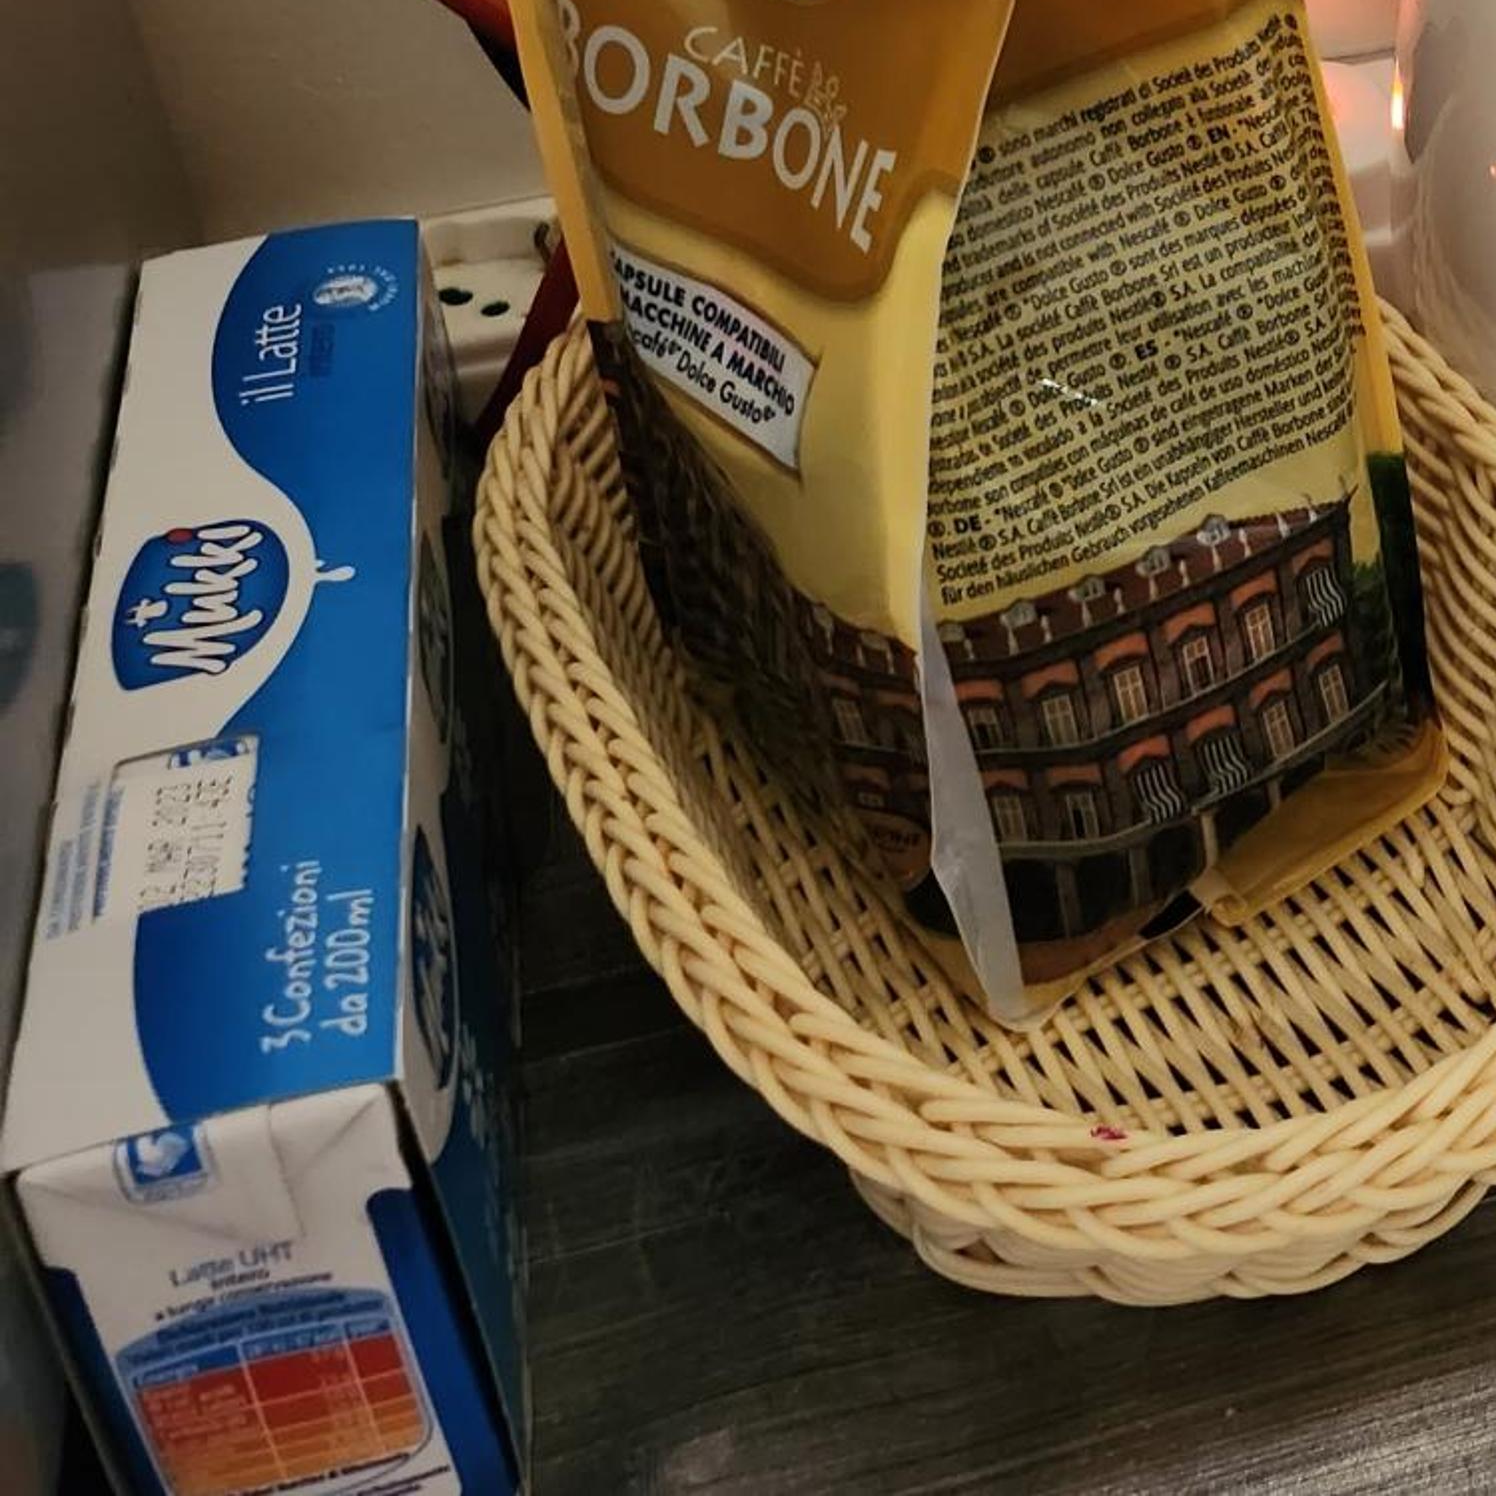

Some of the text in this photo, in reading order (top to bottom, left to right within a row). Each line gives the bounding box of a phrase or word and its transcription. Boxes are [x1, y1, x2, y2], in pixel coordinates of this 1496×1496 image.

[684, 26, 805, 98] CAFFÈ
[1099, 118, 1127, 139] non
[1126, 120, 1182, 151] Borbone
[1033, 180, 1086, 213] Nescafé
[1106, 160, 1144, 184] Dolce
[1145, 143, 1184, 168] Gusto
[1206, 124, 1230, 144] EN
[1036, 216, 1051, 237] of
[1101, 191, 1126, 211] des
[1125, 168, 1181, 199] Produits
[996, 255, 1022, 278] and
[1021, 251, 1036, 267] is
[1035, 240, 1059, 261] not
[1059, 212, 1125, 250] connected
[1125, 201, 1155, 223] with
[1202, 173, 1226, 193] des
[1011, 256, 1083, 294] compatible
[1087, 241, 1116, 262] with
[1193, 196, 1231, 220] Dolce
[1068, 217, 1239, 294] Gusto sont des marques
[610, 250, 686, 307] APSULE
[692, 294, 785, 373] COMPATIBILI
[995, 332, 1014, 351] La
[1100, 273, 1157, 305] Borbone
[1159, 260, 1179, 282] Srl
[1181, 252, 1203, 273] est
[1203, 246, 1223, 264] un
[1023, 341, 1048, 362] des
[1051, 317, 1106, 352] produits
[1197, 272, 1217, 290] La
[1025, 366, 1044, 385] de
[1047, 338, 1111, 377] permettre
[1114, 324, 1142, 345] leur
[1147, 299, 1211, 333] utilisation
[1246, 275, 1268, 294] les
[1255, 303, 1310, 335] Borbone
[243, 303, 301, 382] Latte
[677, 350, 716, 393] Dolce
[710, 341, 724, 364] A
[726, 355, 795, 416] MARCHIO
[1066, 338, 1159, 389] Gusto ES
[1156, 376, 1182, 396] des
[1184, 354, 1240, 383] Produits
[1066, 445, 1089, 465] con
[1149, 405, 1167, 423] de
[1169, 389, 1197, 414] café
[1198, 384, 1216, 402] de
[1218, 375, 1243, 394] uso
[1233, 398, 1295, 429] Hersteller
[1297, 383, 1322, 407] und
[952, 513, 982, 534] DE
[1096, 448, 1133, 473] Gusto
[1263, 369, 1313, 397] Marken
[990, 551, 1016, 570] des
[1018, 530, 1074, 559] Produits
[1143, 479, 1167, 499] Die
[1210, 443, 1235, 464] von
[1271, 407, 1325, 438] Borbone
[965, 580, 994, 599] den
[1071, 526, 1129, 563] Gebrauch
[1203, 439, 1304, 491] Kaffeemaschinen
[142, 522, 264, 675] Mukki
[260, 859, 323, 1054] 3 Confezioni
[320, 993, 369, 1036] da
[239, 1239, 294, 1268] UHT
